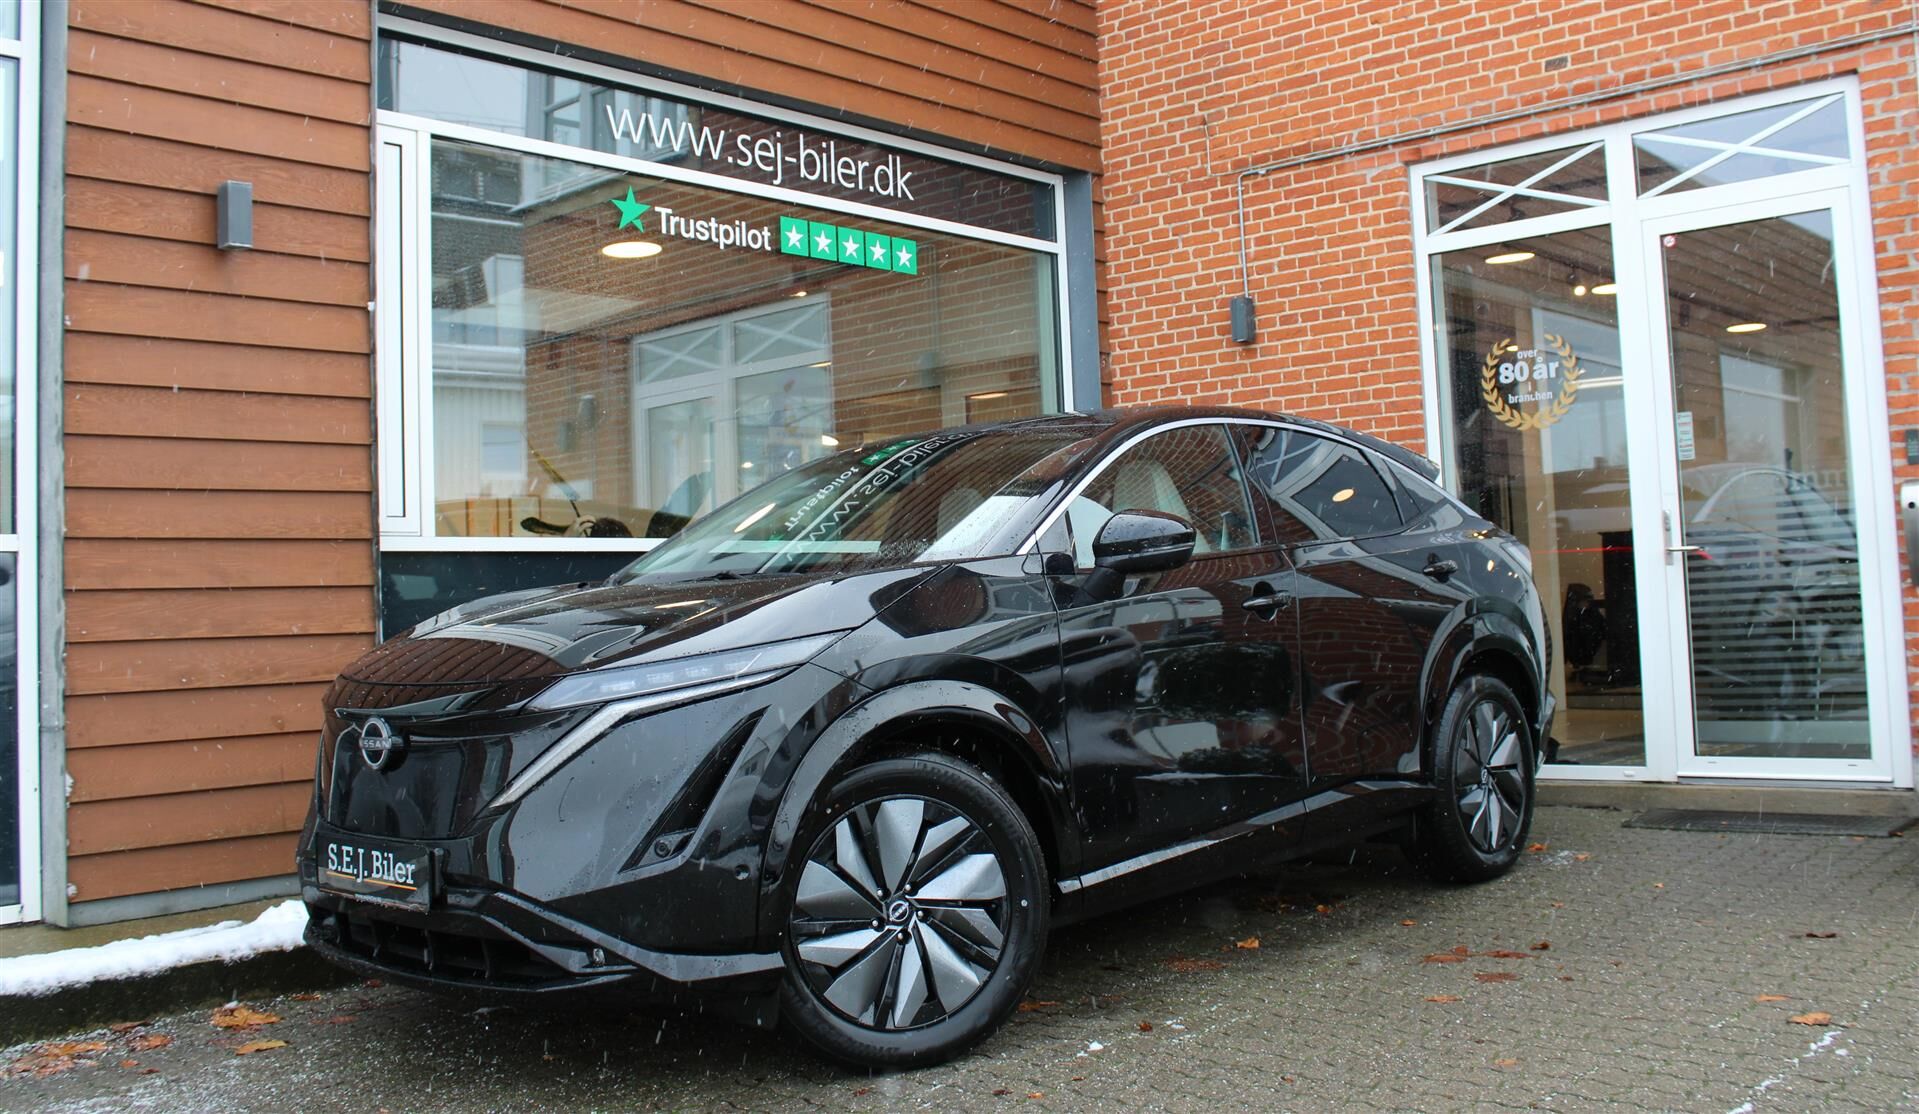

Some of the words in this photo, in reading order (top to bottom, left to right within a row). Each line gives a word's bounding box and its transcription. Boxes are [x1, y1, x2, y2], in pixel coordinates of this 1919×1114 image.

[606, 104, 915, 201] www.sej-biler.dk
[654, 205, 772, 252] Trustpilot
[1499, 361, 1530, 384] 80
[1532, 356, 1559, 380] år
[1517, 349, 1538, 359] over
[328, 843, 368, 883] S.E.J.
[371, 850, 416, 884] Biler
